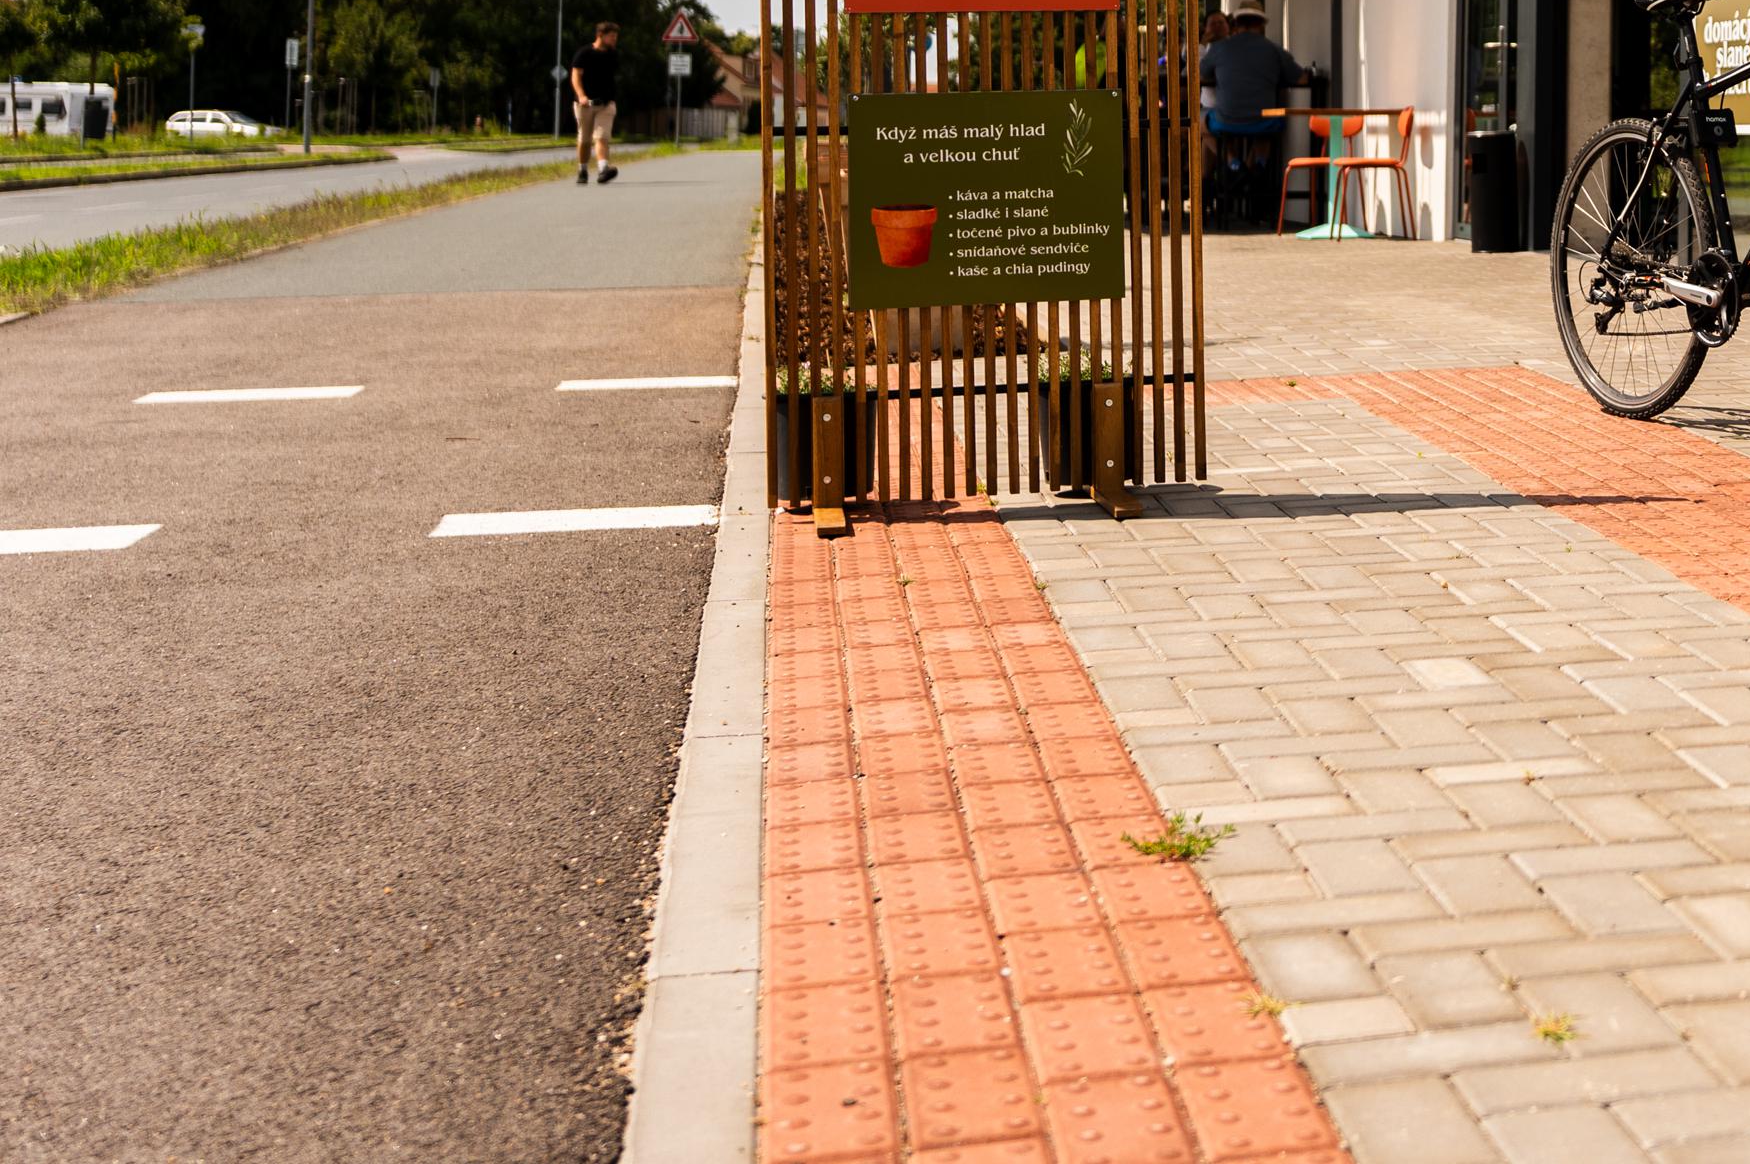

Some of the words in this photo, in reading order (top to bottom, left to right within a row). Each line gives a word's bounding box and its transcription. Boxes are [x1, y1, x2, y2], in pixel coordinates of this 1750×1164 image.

[1716, 40, 1750, 69] slané
[876, 126, 917, 144] Když
[922, 125, 958, 140] máš
[963, 123, 1004, 141] malý
[1009, 122, 1046, 137] hlad
[903, 153, 914, 164] a
[919, 148, 976, 163] velkou
[982, 147, 1021, 161] chuť
[956, 189, 988, 201] káva
[992, 191, 1001, 200] a
[1004, 187, 1054, 200] matcha
[956, 207, 1001, 220] sladké
[1005, 207, 1009, 219] i
[1013, 205, 1049, 218] slané
[956, 226, 1003, 239] točené
[1007, 225, 1036, 240] pivo
[1040, 227, 1049, 236] a
[1052, 222, 1110, 237] bublinky
[956, 244, 1026, 258] snídaňové
[1030, 242, 1089, 255] sendviče
[957, 265, 989, 277] kaše
[992, 266, 1001, 276] a
[1005, 262, 1034, 275] chia
[1037, 261, 1091, 277] pudingy
